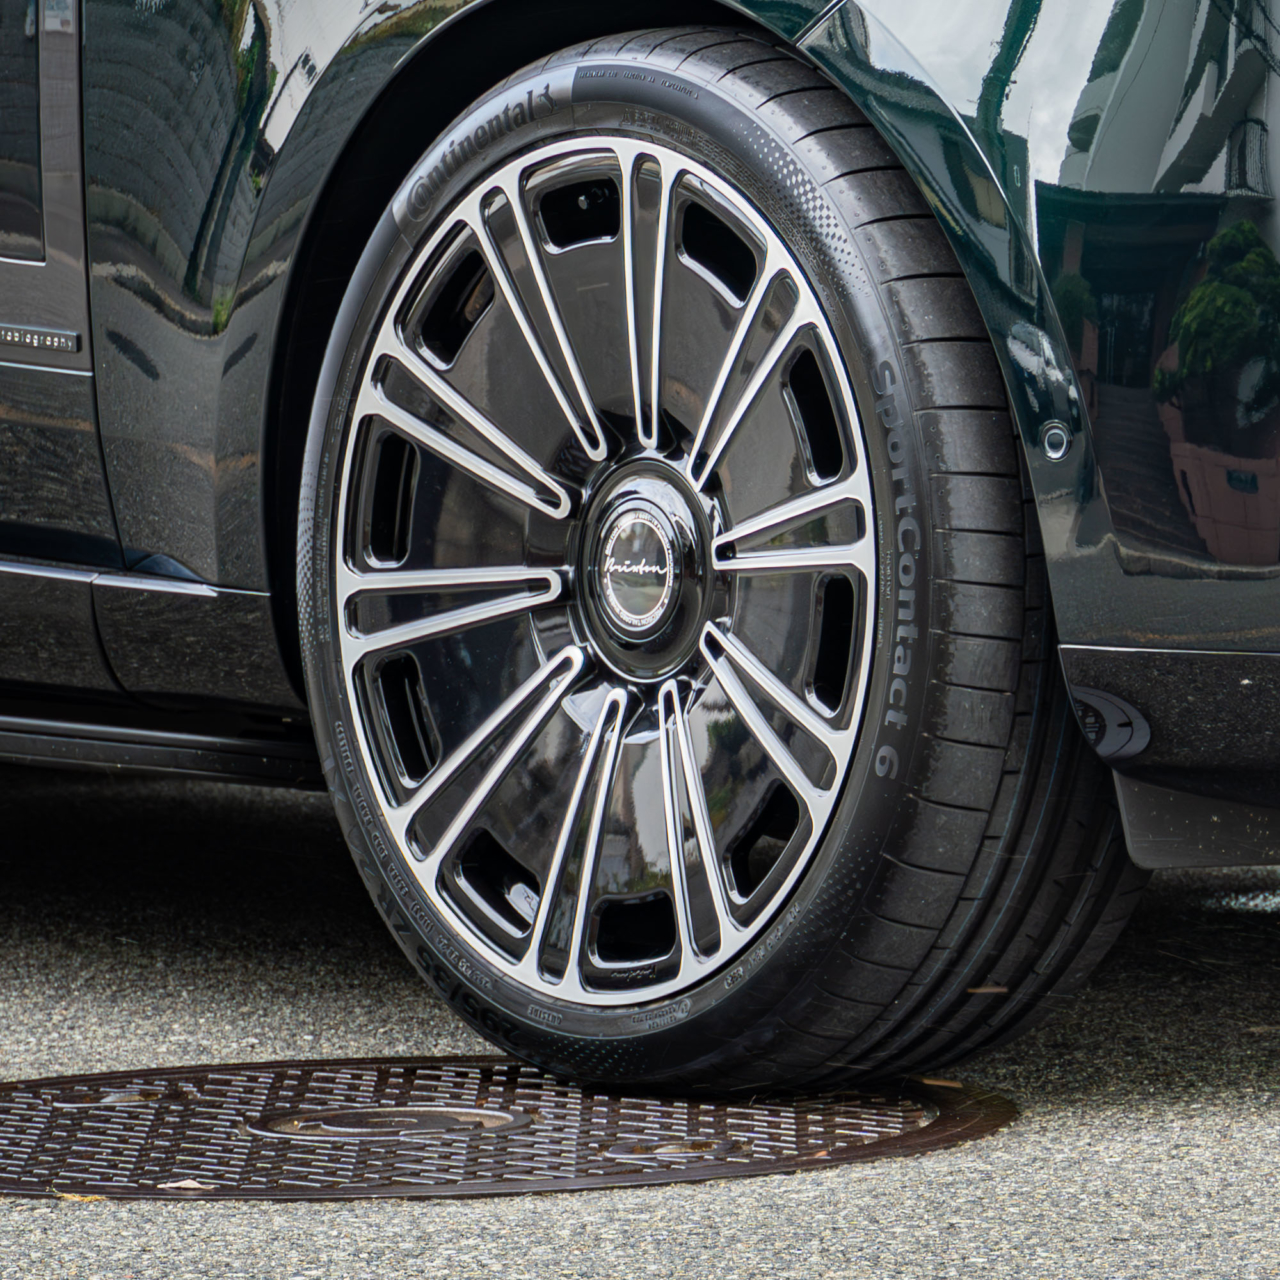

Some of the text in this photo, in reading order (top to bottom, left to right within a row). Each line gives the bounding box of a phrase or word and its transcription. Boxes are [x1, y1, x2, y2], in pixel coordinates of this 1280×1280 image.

[407, 88, 535, 222] Continental
[604, 557, 668, 575] Brixton
[875, 745, 899, 780] 6
[376, 881, 411, 945] ZR
[413, 941, 521, 1046] 295/35
[528, 1004, 562, 1025] OUTSIDE
